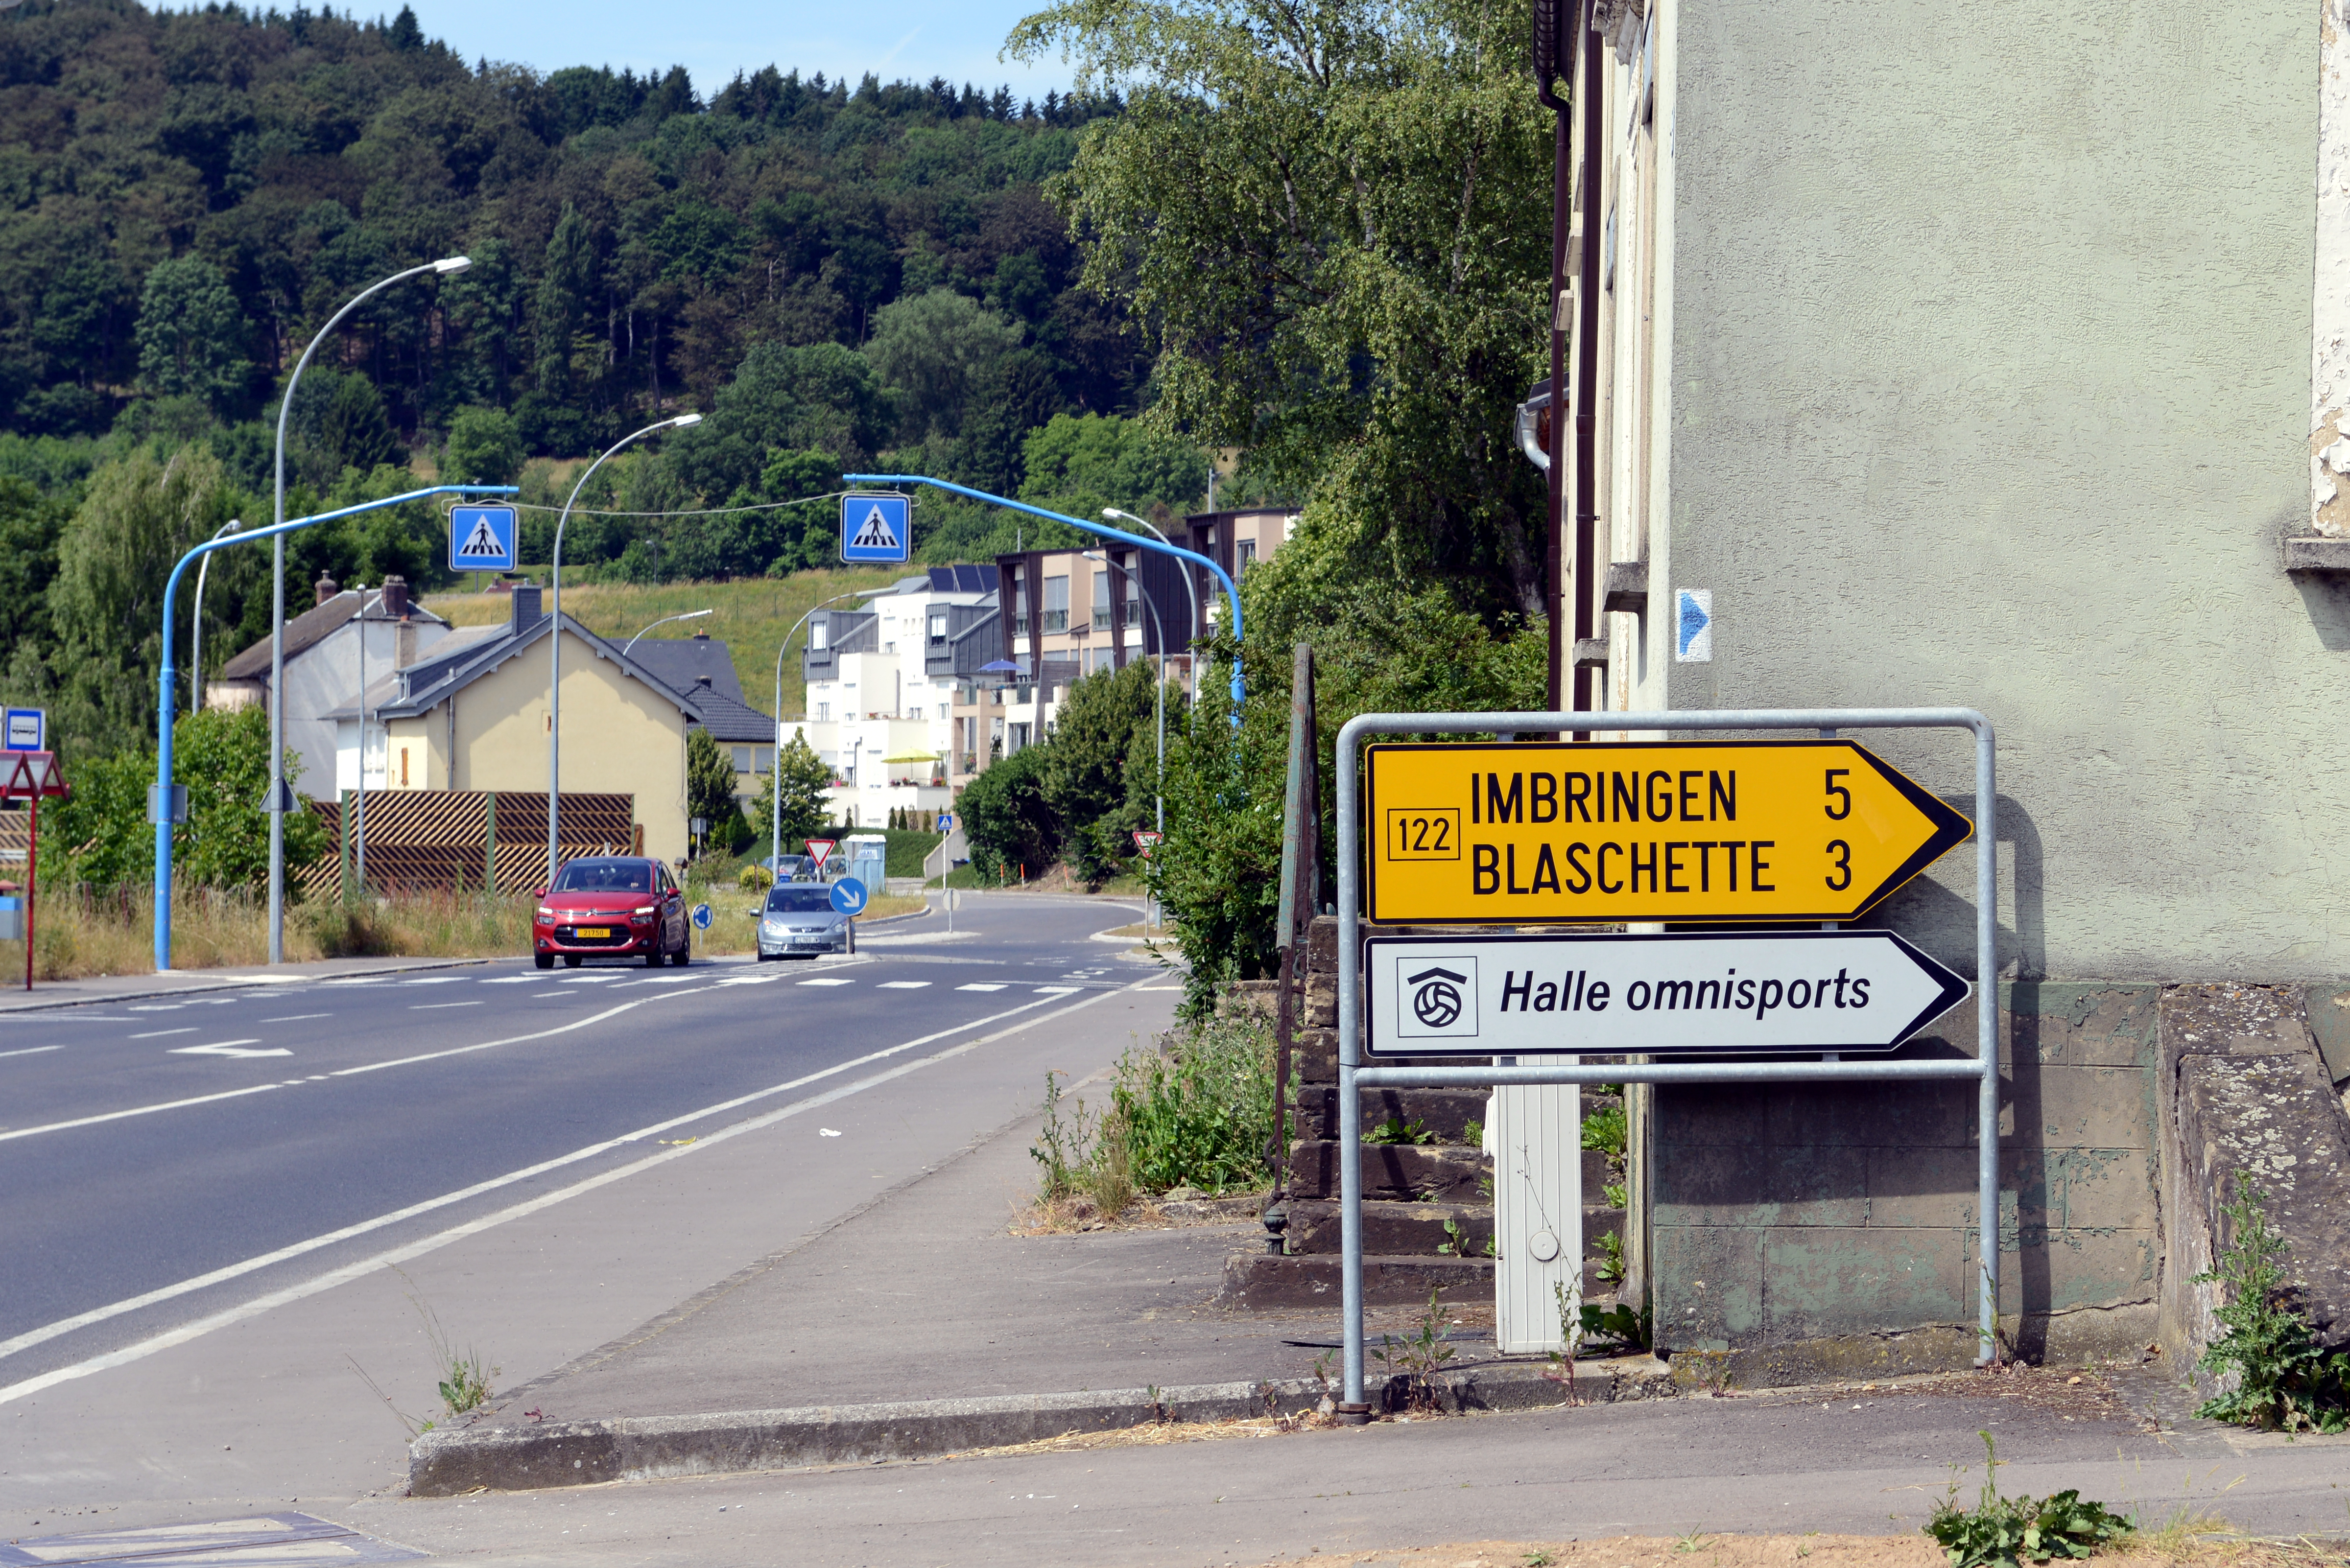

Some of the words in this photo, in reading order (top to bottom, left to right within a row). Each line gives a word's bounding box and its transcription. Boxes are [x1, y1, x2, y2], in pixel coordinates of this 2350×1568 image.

[1472, 770, 1736, 824] IMBRINGEN
[1825, 769, 1851, 820] 5
[1399, 818, 1450, 851] 122
[1472, 841, 1775, 895] BLASCHETTE
[1825, 839, 1852, 891] 3
[1500, 970, 1610, 1012] Halle
[1627, 968, 1871, 1020] omnisports
